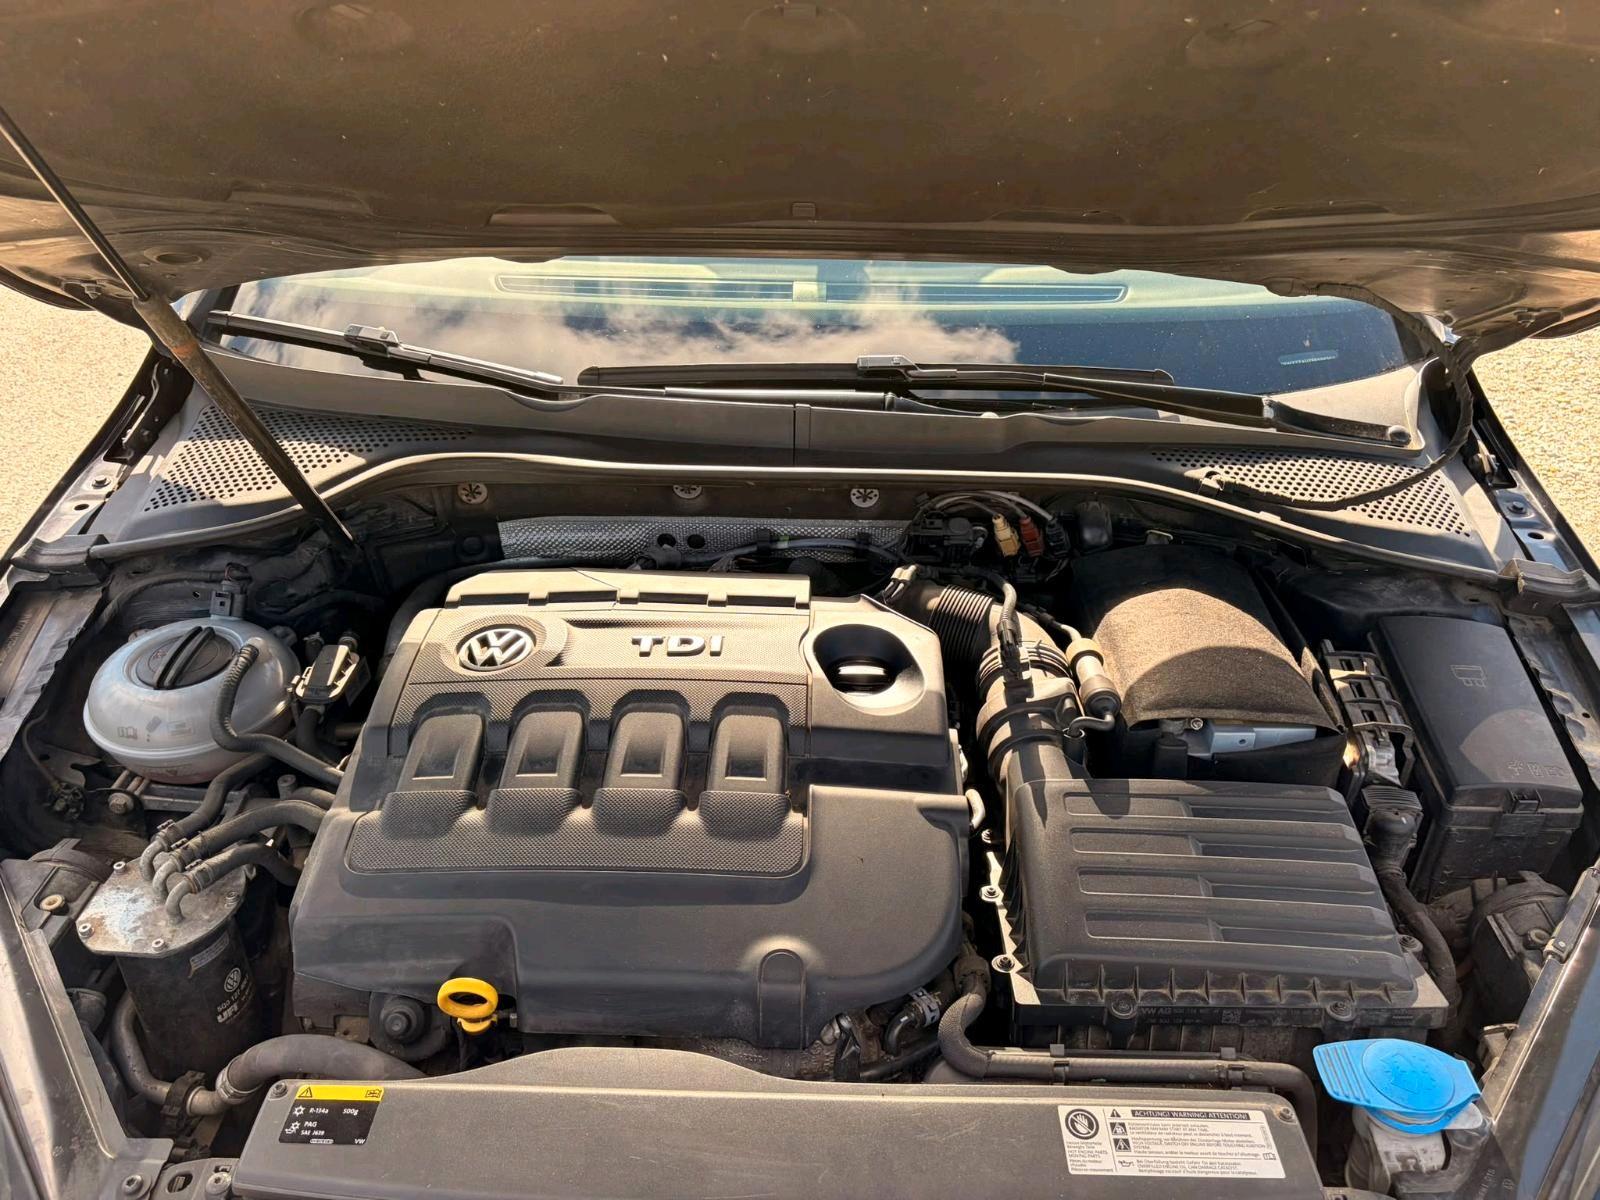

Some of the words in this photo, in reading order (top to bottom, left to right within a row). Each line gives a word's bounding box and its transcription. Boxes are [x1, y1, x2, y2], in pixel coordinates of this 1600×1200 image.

[458, 628, 535, 671] VW
[631, 634, 725, 657] TDI
[342, 1107, 359, 1116] 500g
[1171, 1111, 1207, 1119] WARNING!
[1208, 1112, 1248, 1120] ATTENTION!
